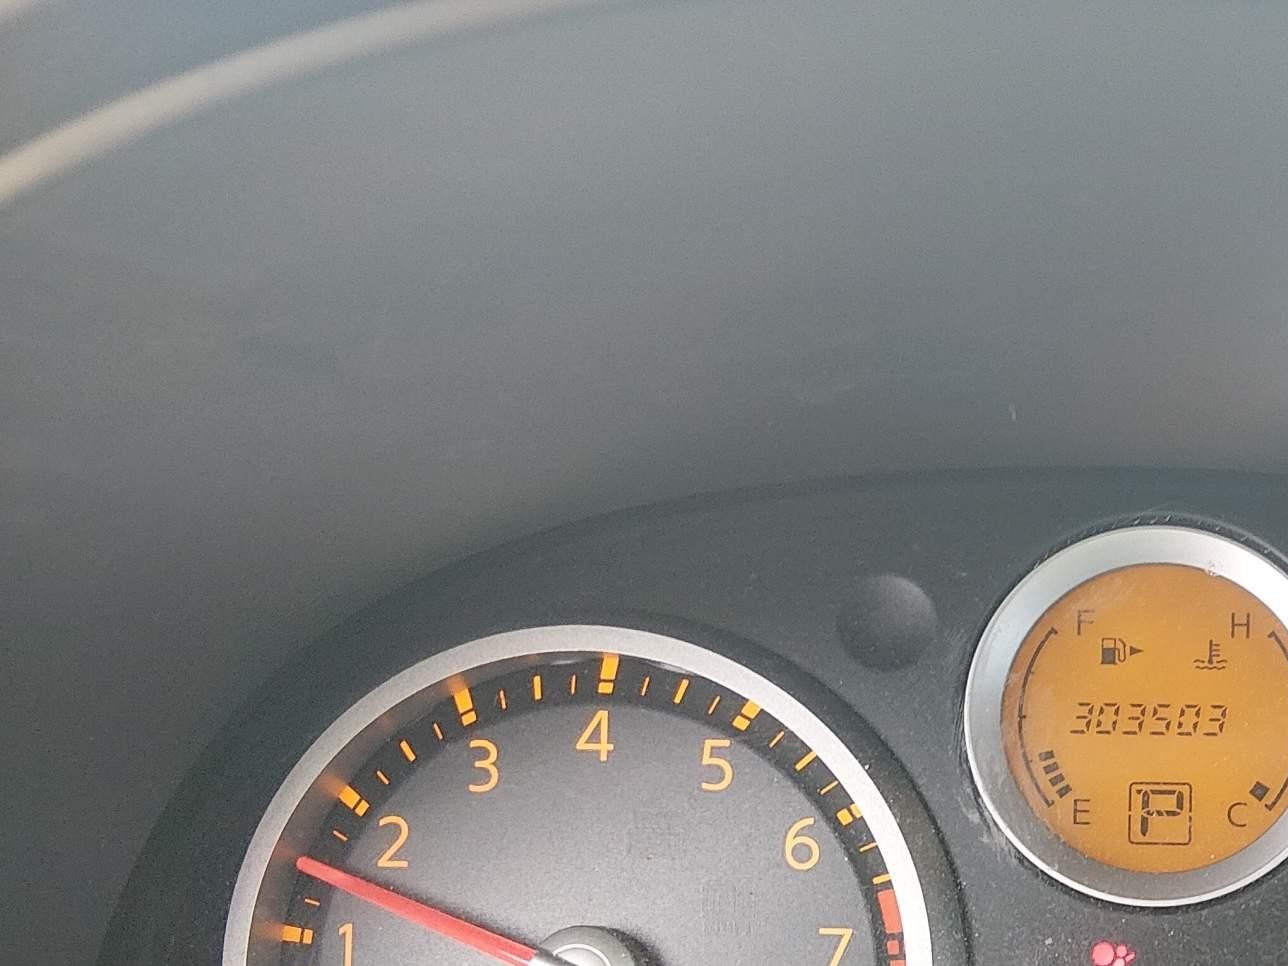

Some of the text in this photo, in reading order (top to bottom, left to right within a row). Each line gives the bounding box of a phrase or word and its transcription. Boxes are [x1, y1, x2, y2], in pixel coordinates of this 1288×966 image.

[1077, 609, 1095, 635] F
[1231, 612, 1250, 638] H
[576, 709, 614, 761] 4
[1069, 702, 1228, 736] 303503
[468, 740, 499, 793] 3
[701, 740, 734, 792] 5
[1073, 798, 1091, 825] E
[1136, 788, 1184, 837] P
[1227, 802, 1247, 827] C
[377, 816, 411, 868] 2
[784, 817, 820, 871] 6
